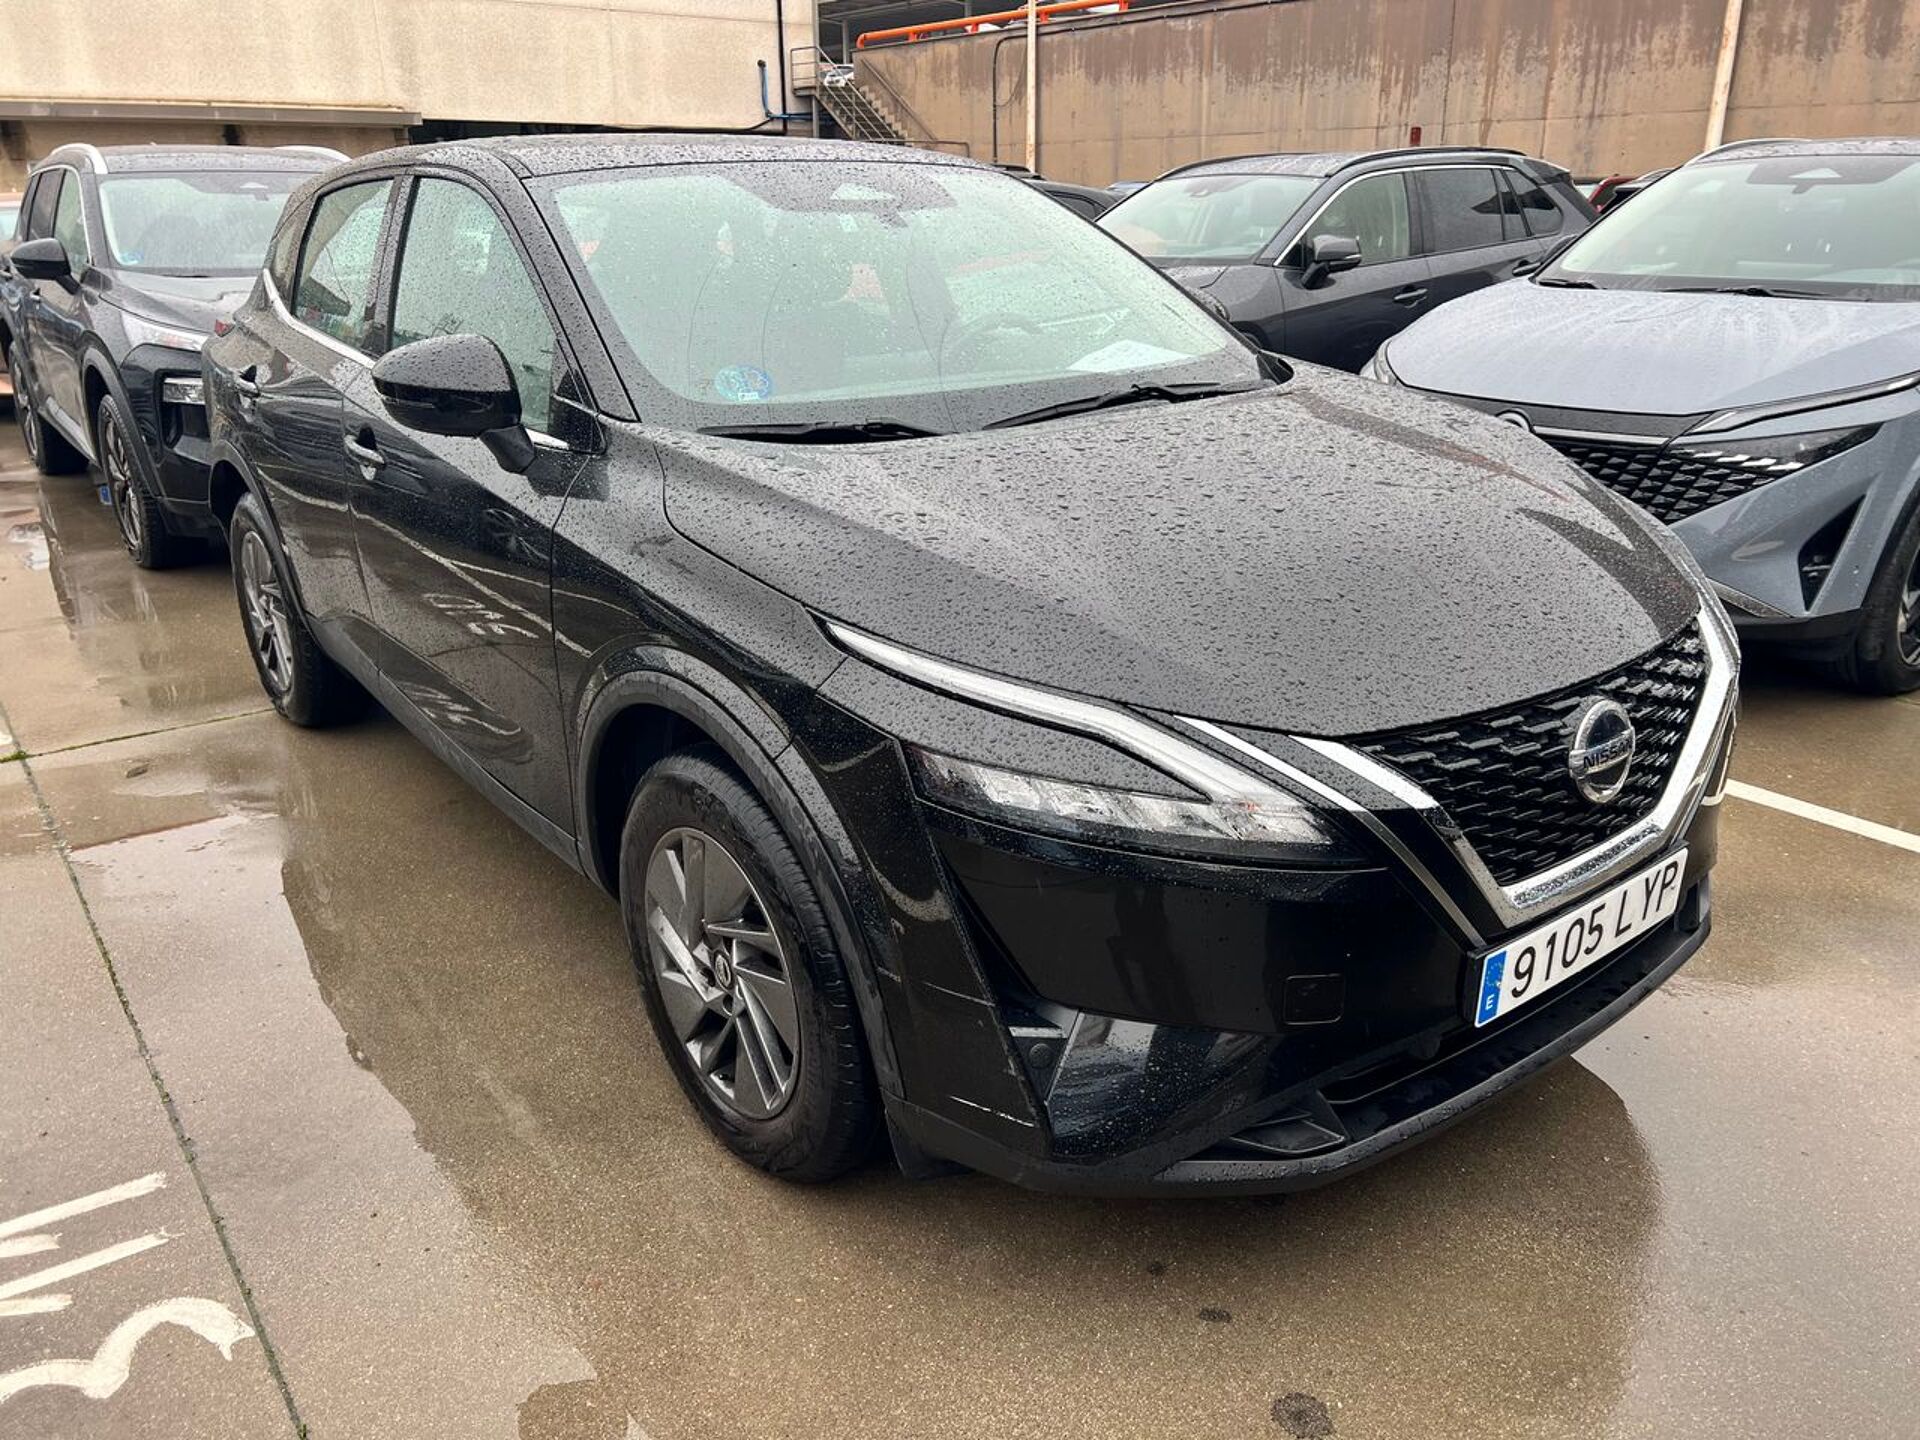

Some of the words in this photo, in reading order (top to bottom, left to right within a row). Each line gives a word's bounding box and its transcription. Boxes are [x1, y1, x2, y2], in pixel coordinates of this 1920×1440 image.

[1583, 737, 1633, 770] NISSAN
[1511, 902, 1607, 999] 9105
[1614, 860, 1679, 938] LYP
[1484, 993, 1495, 1011] E
